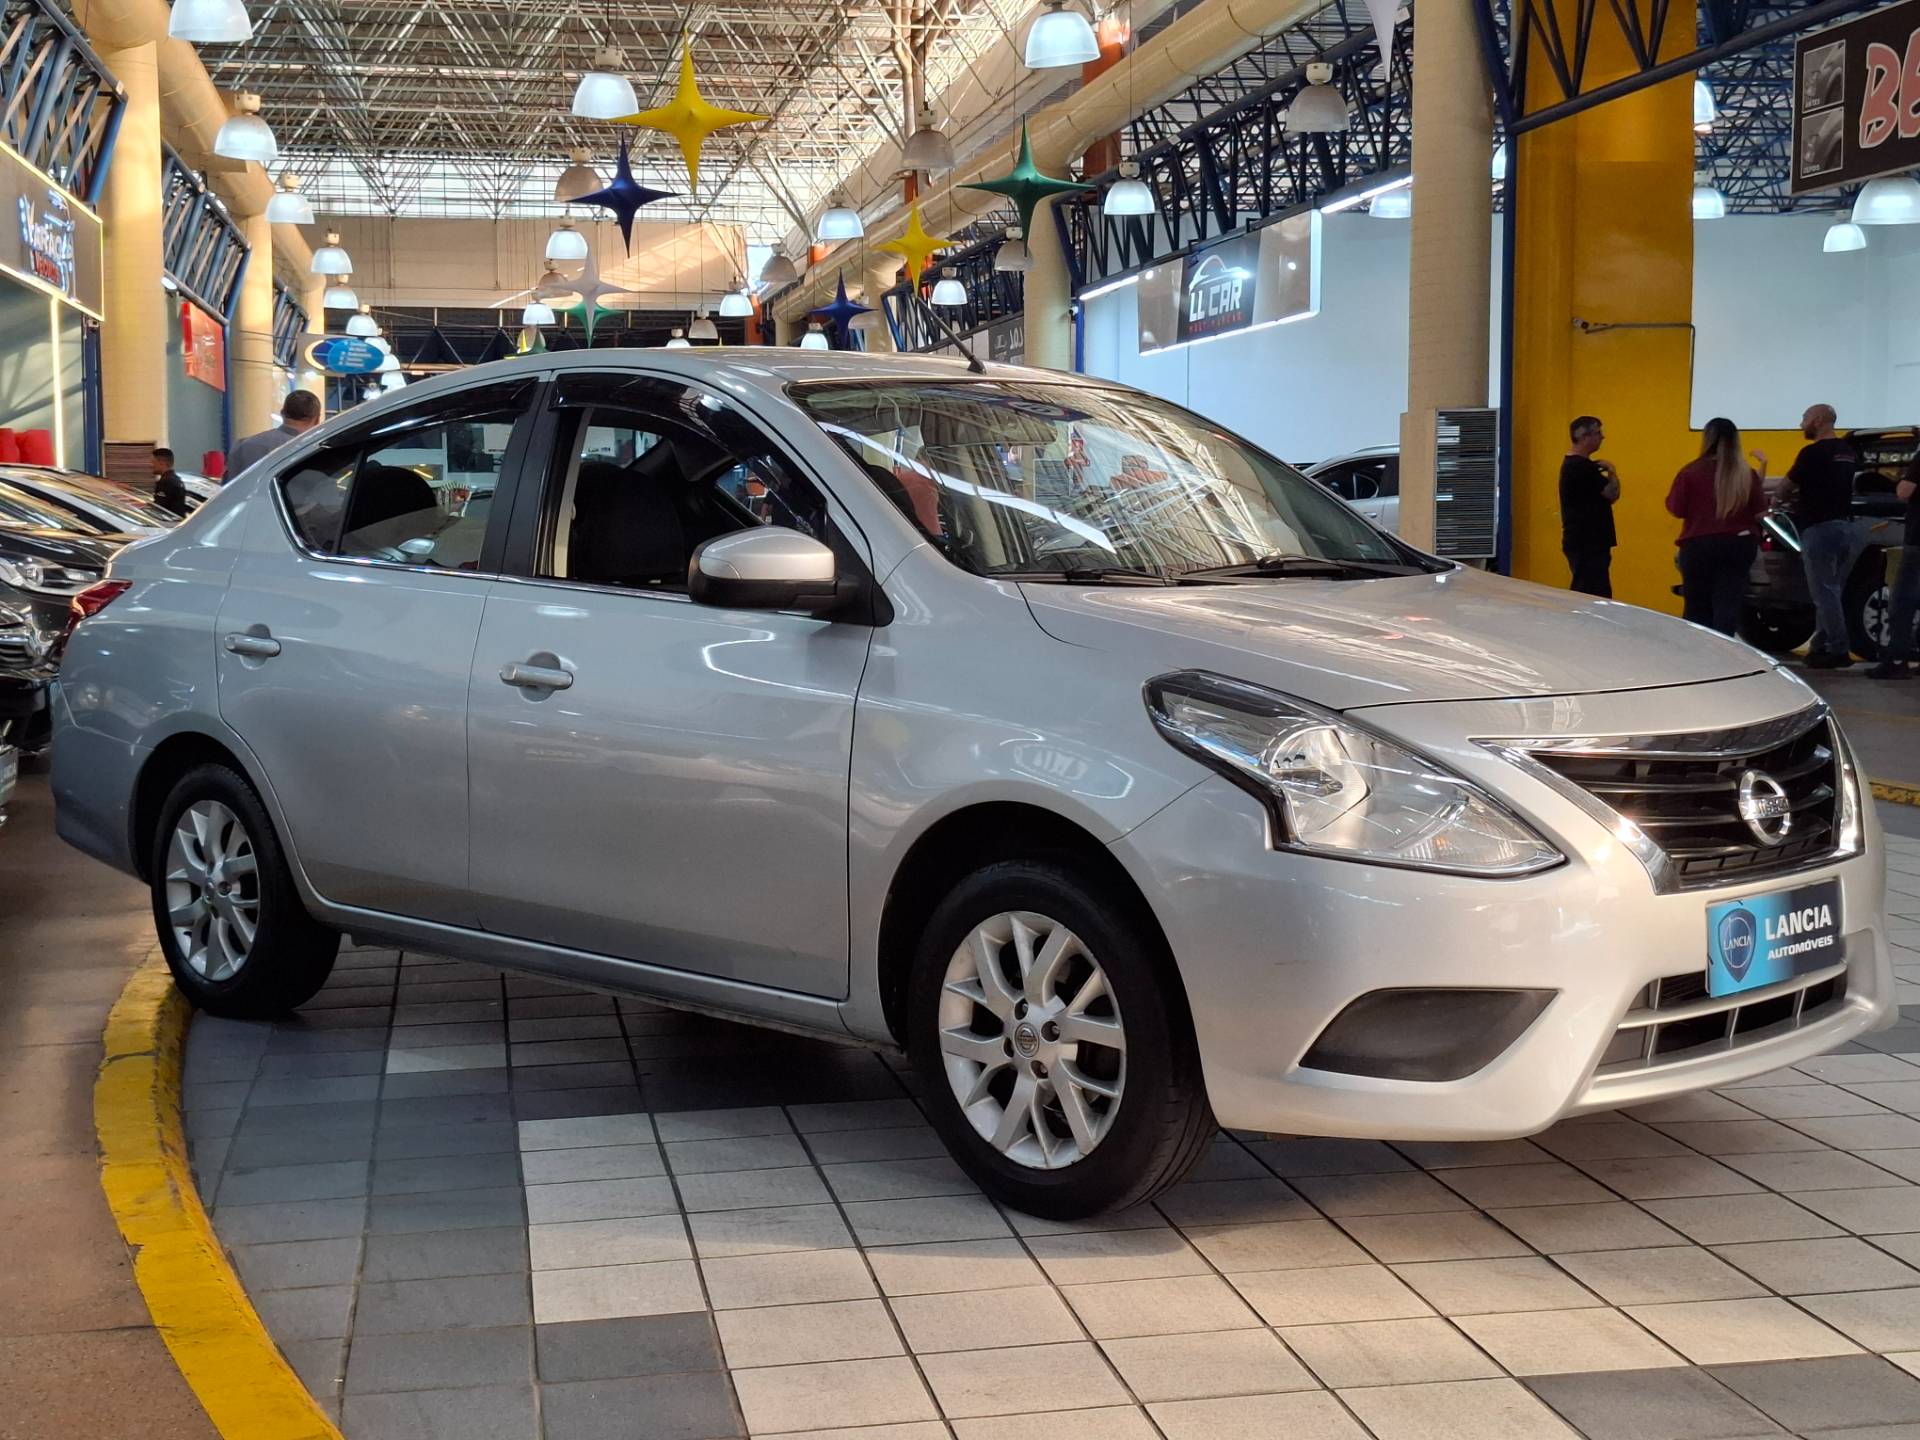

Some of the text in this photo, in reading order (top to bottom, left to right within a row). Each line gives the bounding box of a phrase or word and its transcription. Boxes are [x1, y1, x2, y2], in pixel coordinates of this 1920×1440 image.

[1189, 279, 1242, 322] LL CAR
[1765, 904, 1832, 940] LANCIA
[1723, 936, 1752, 951] LANCIA
[1767, 935, 1833, 960] AUTOMÓVEIS
